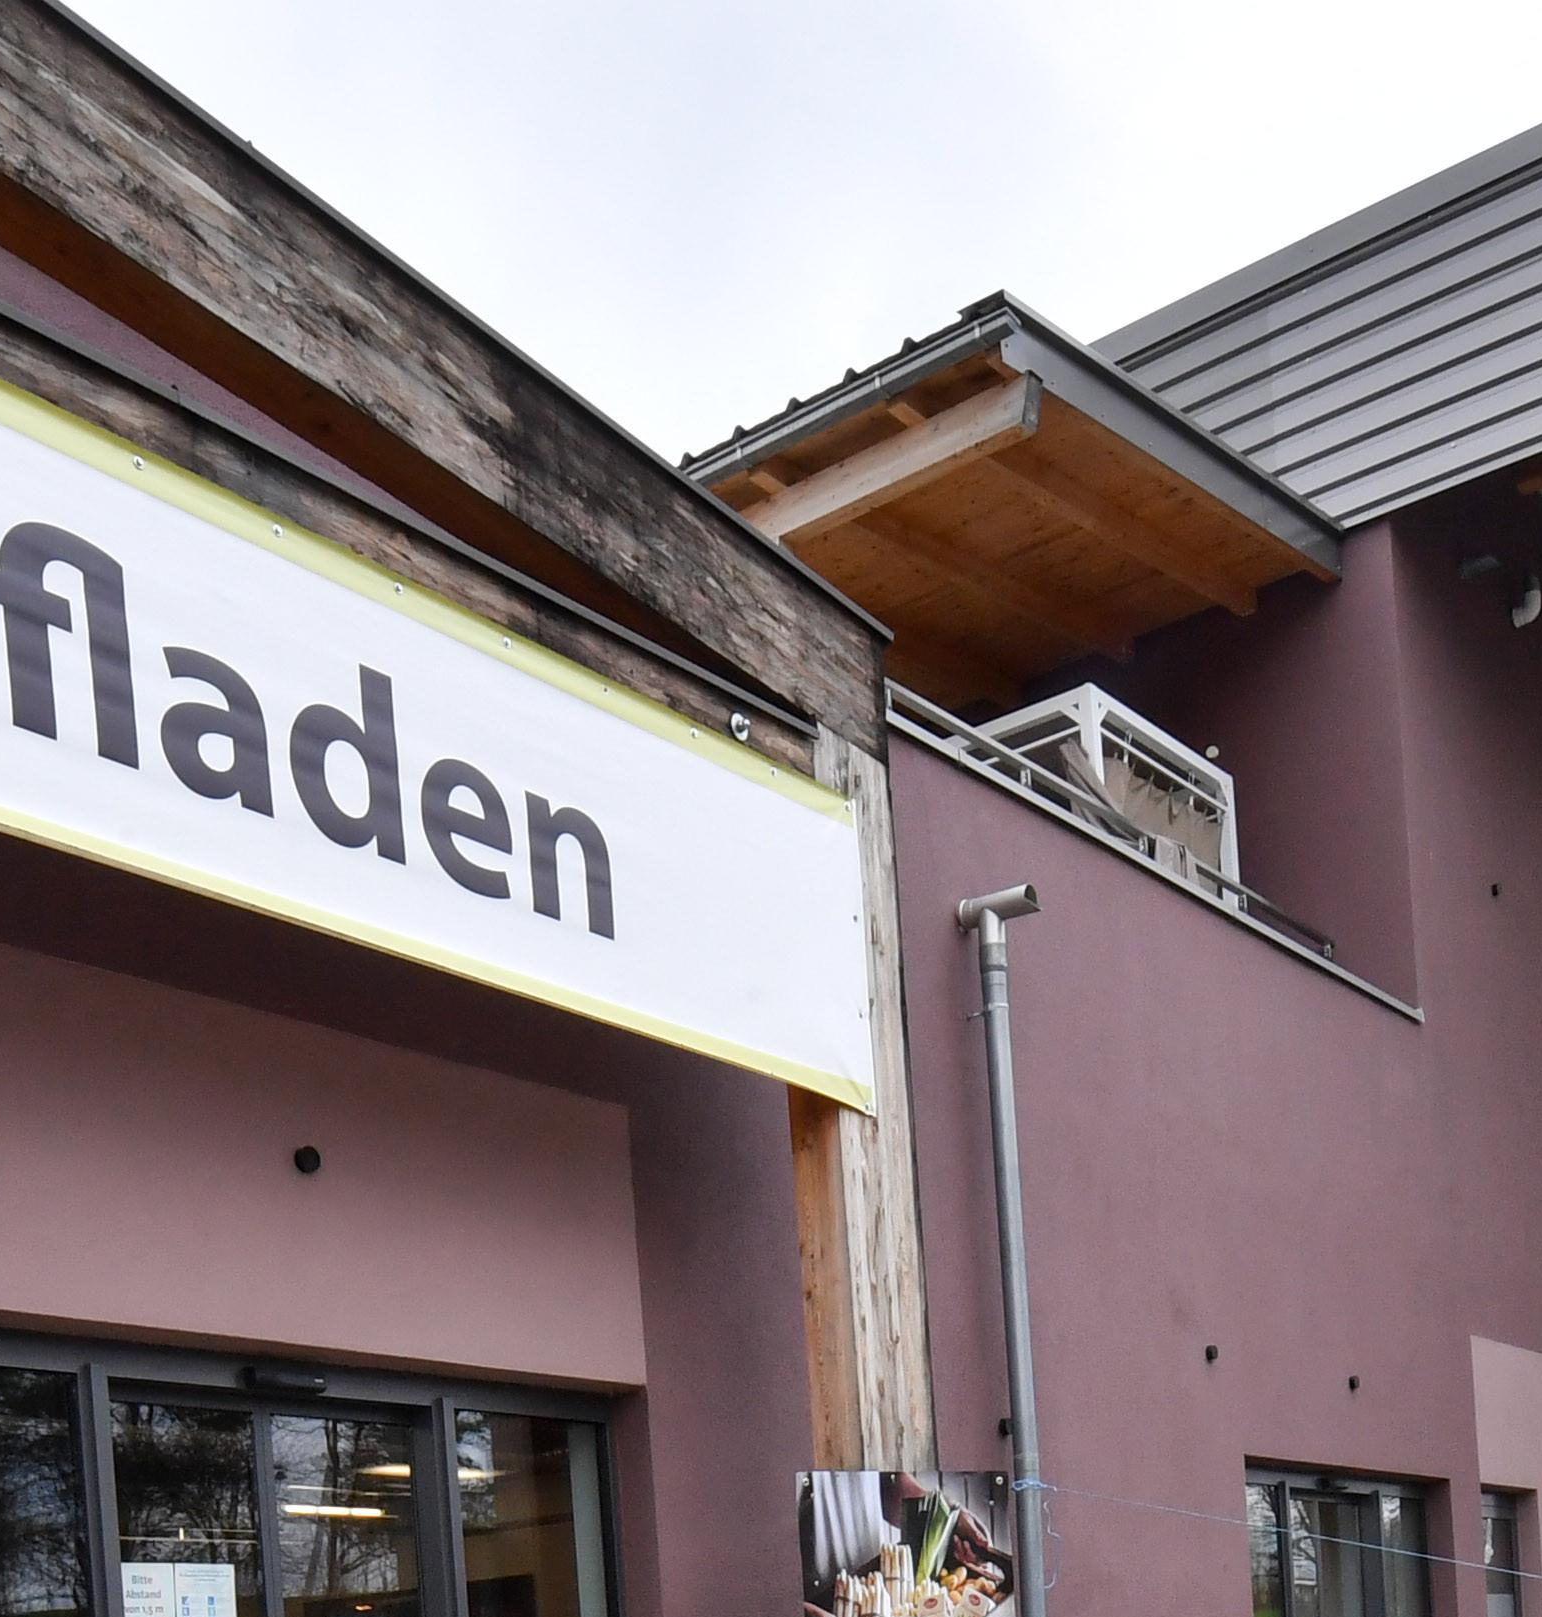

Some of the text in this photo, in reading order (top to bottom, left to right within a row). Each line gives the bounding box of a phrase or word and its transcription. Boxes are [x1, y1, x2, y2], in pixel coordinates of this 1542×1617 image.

[131, 1575, 153, 1584] Bitte
[125, 1589, 162, 1599] Abstand
[155, 1606, 164, 1614] m
